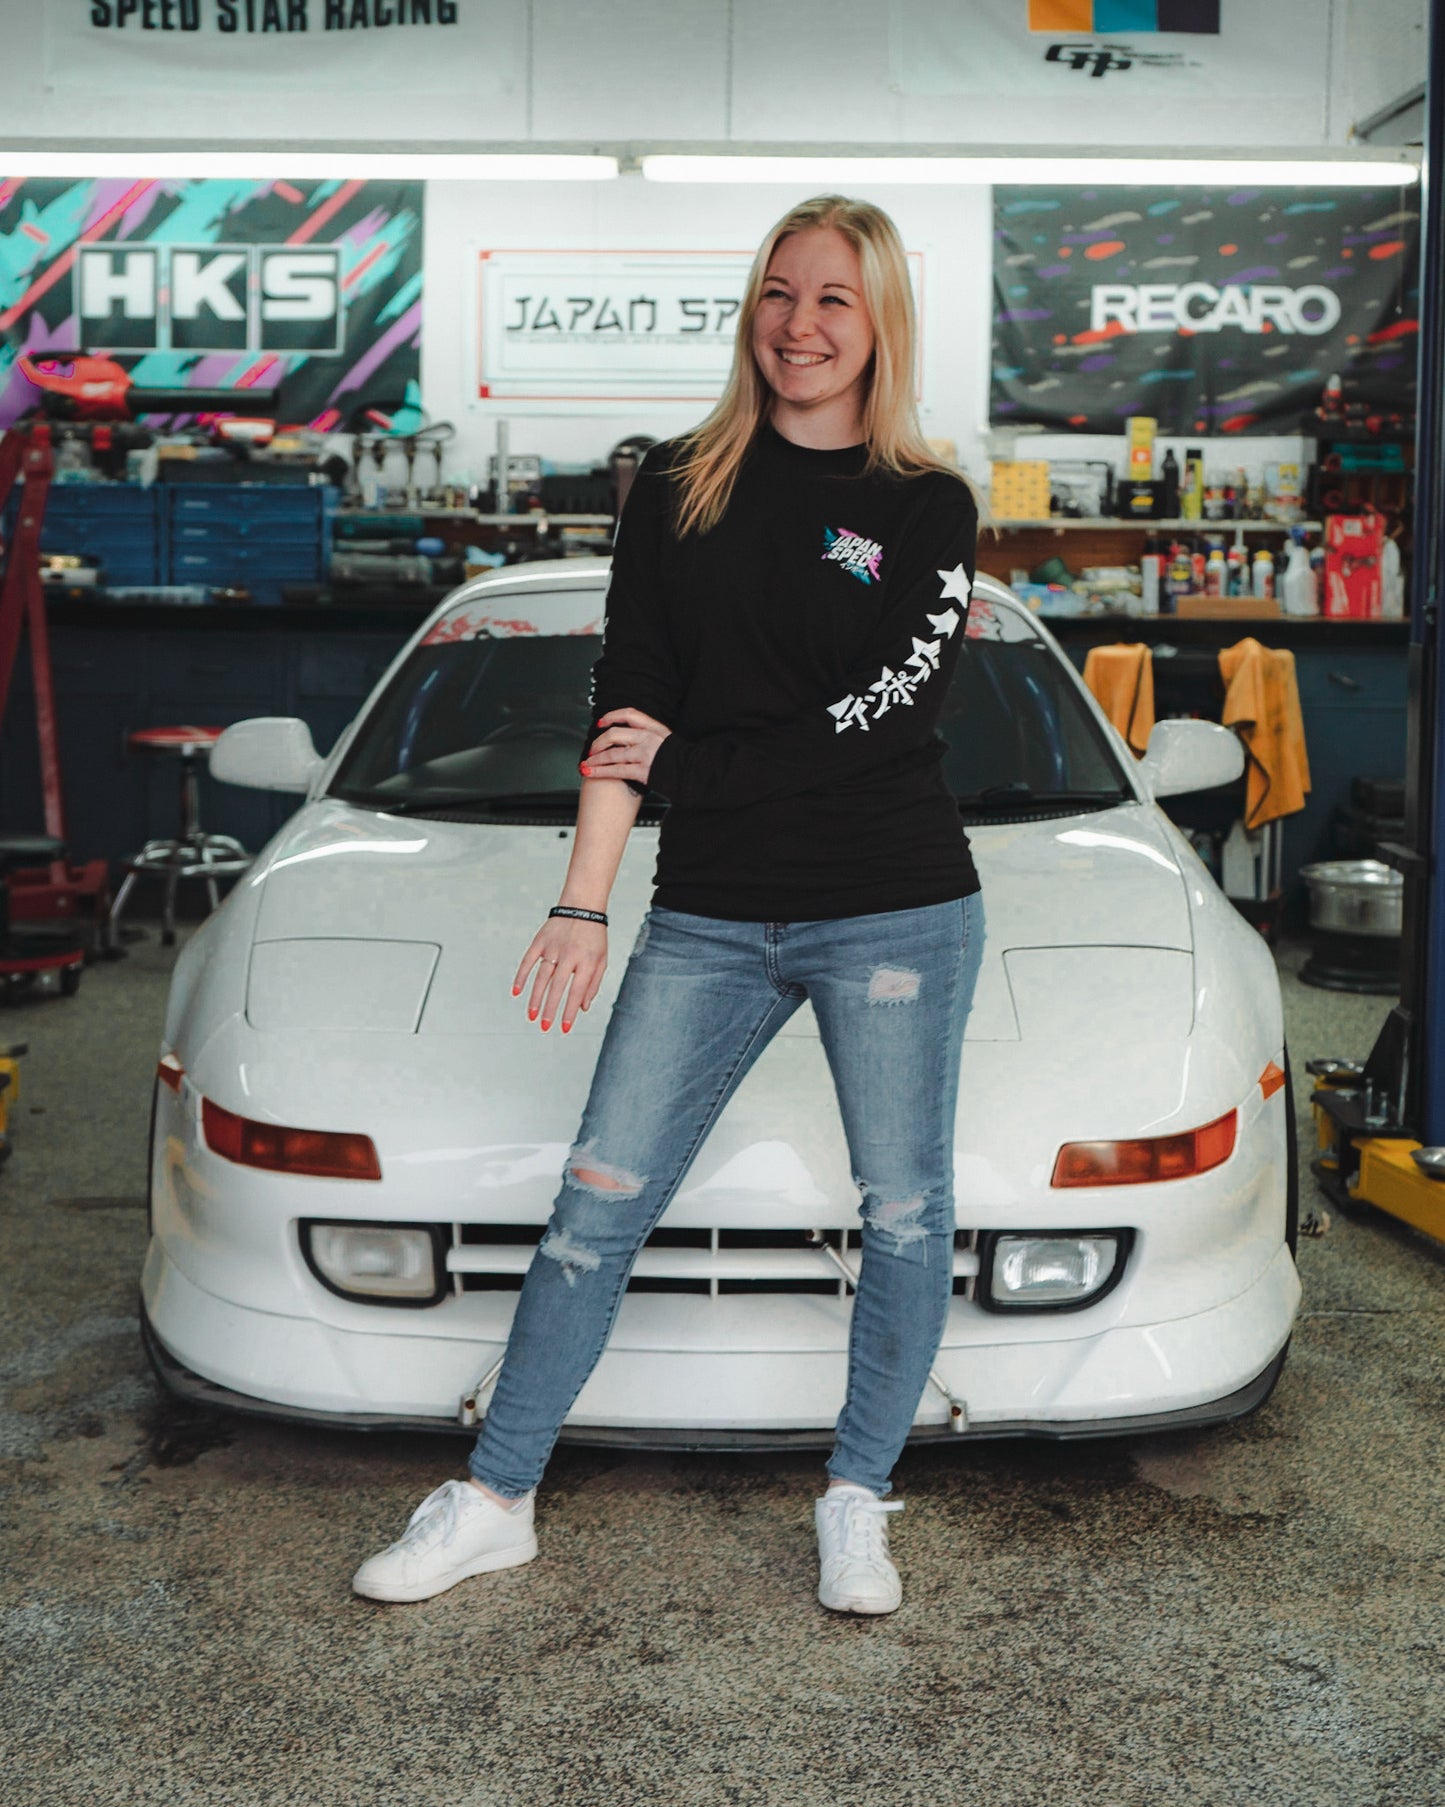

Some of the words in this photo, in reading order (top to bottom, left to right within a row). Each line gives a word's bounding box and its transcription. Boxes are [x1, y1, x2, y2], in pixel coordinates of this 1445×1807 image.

[91, 0, 200, 31] SPEED
[217, 0, 307, 32] STAR
[324, 0, 458, 30] RACING
[81, 252, 336, 320] HKS
[506, 296, 656, 331] JAPAN
[680, 299, 740, 331] SP
[1091, 282, 1341, 336] RECARO
[827, 547, 873, 567] SPEC
[830, 536, 883, 555] JAPAN
